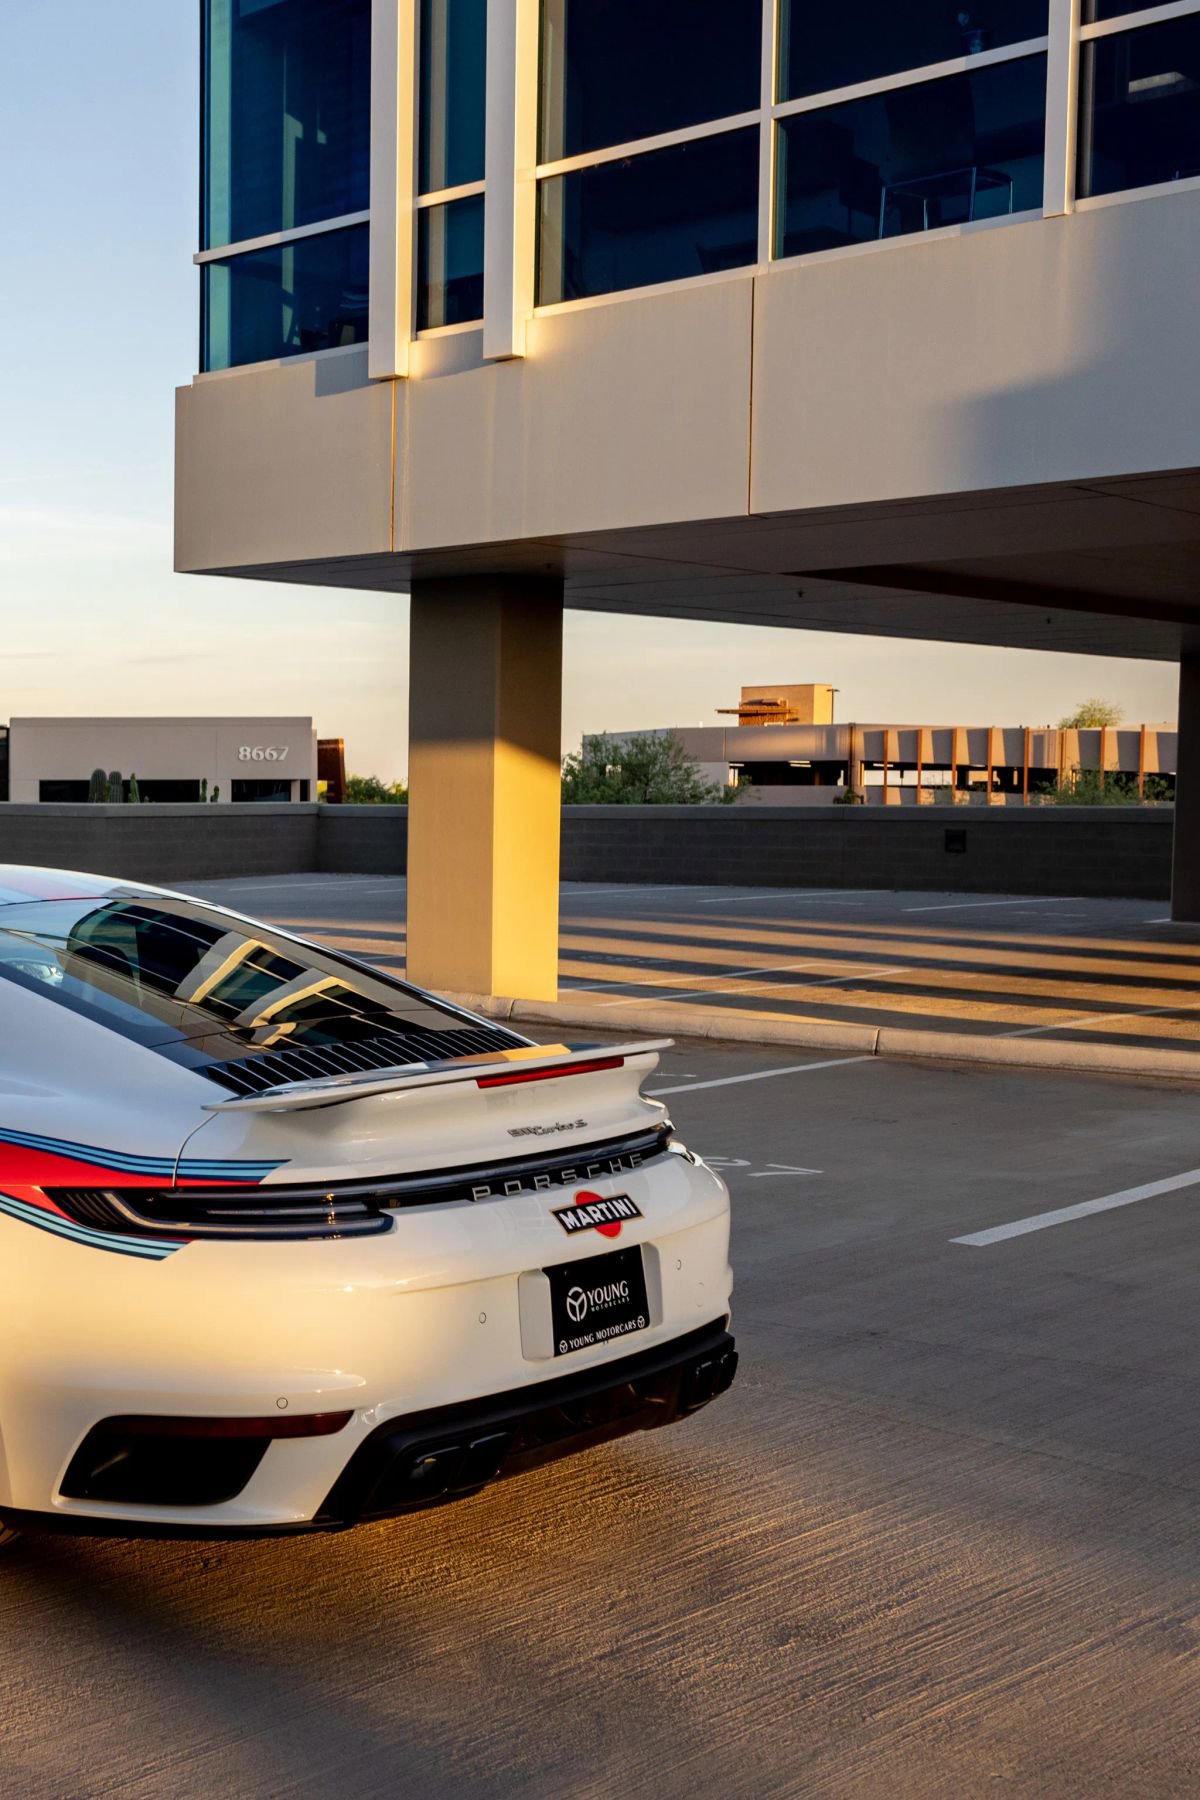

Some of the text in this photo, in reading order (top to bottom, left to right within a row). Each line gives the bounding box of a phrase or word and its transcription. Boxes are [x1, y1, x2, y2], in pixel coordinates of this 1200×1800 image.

[238, 746, 289, 761] 8667
[472, 1153, 643, 1202] PORSCHE
[558, 1198, 638, 1230] MARTINI
[587, 1280, 629, 1306] YOUNG
[569, 1319, 637, 1349] YOUNG MOTORCARS
